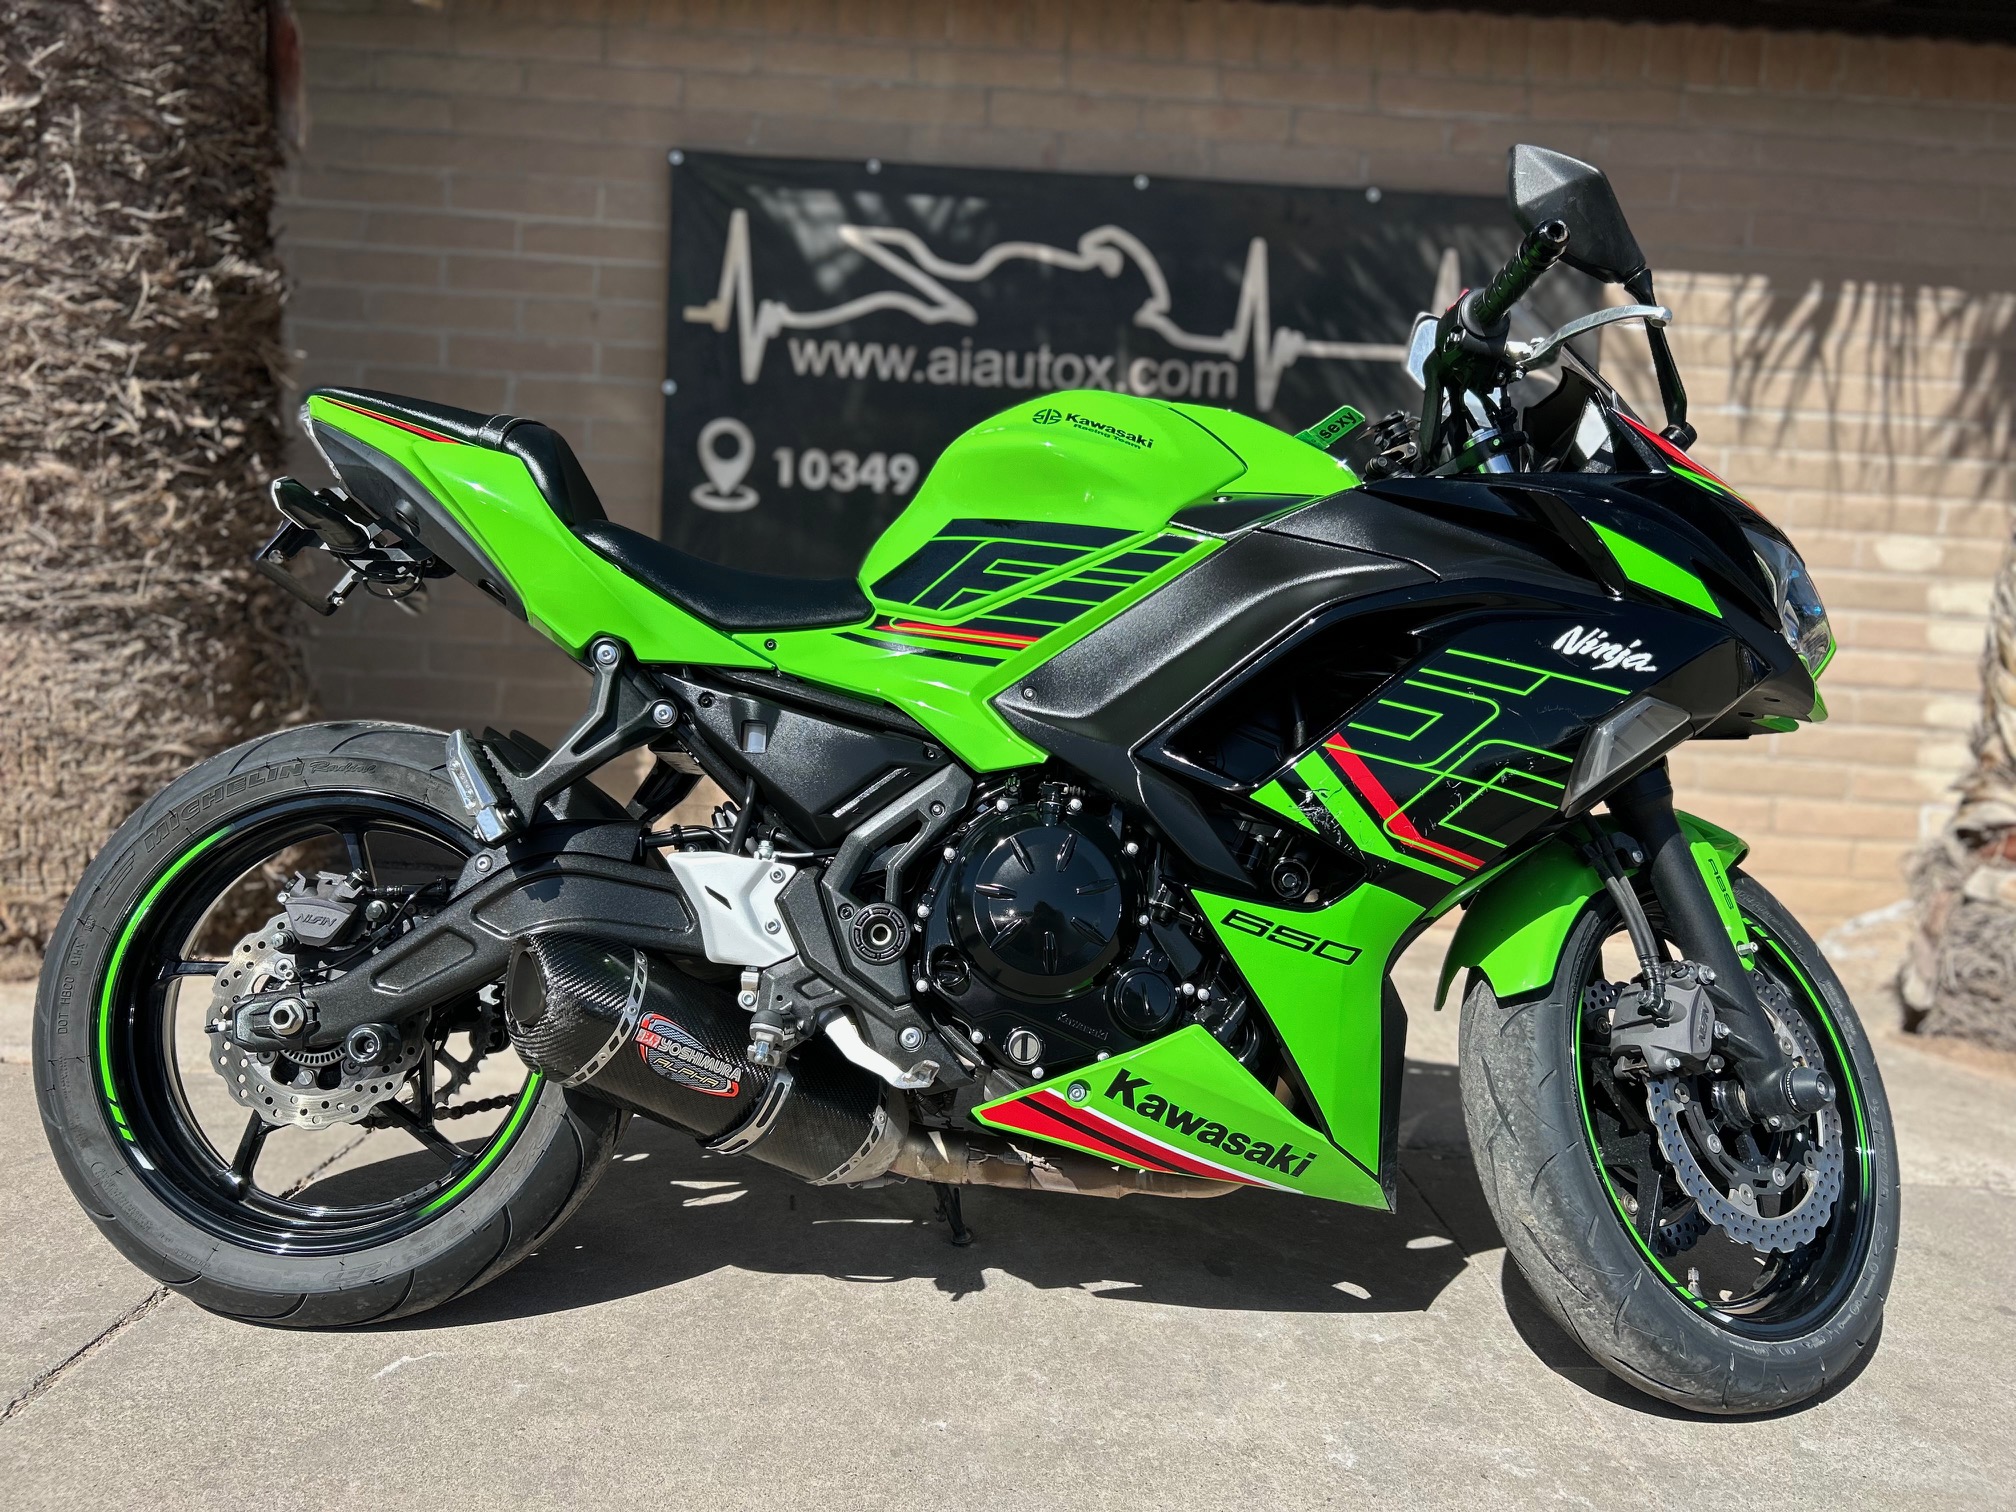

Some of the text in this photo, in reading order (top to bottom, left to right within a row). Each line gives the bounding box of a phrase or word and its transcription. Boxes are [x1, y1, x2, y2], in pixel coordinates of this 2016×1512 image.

[788, 338, 1238, 397] www.aiautox.com
[1065, 413, 1154, 448] Kawasaki
[1073, 423, 1141, 449] Racing Team
[1319, 411, 1357, 439] sexy
[772, 448, 919, 494] 10349
[1552, 625, 1658, 671] Ninja
[143, 760, 305, 853] MICHELIN
[1707, 858, 1735, 910] ABS
[1220, 908, 1364, 965] 650
[57, 1012, 70, 1035] DOT
[652, 1057, 720, 1088] ALPHA
[657, 1036, 742, 1083] YOSHIMURA
[1104, 1067, 1318, 1178] Kawasaki
